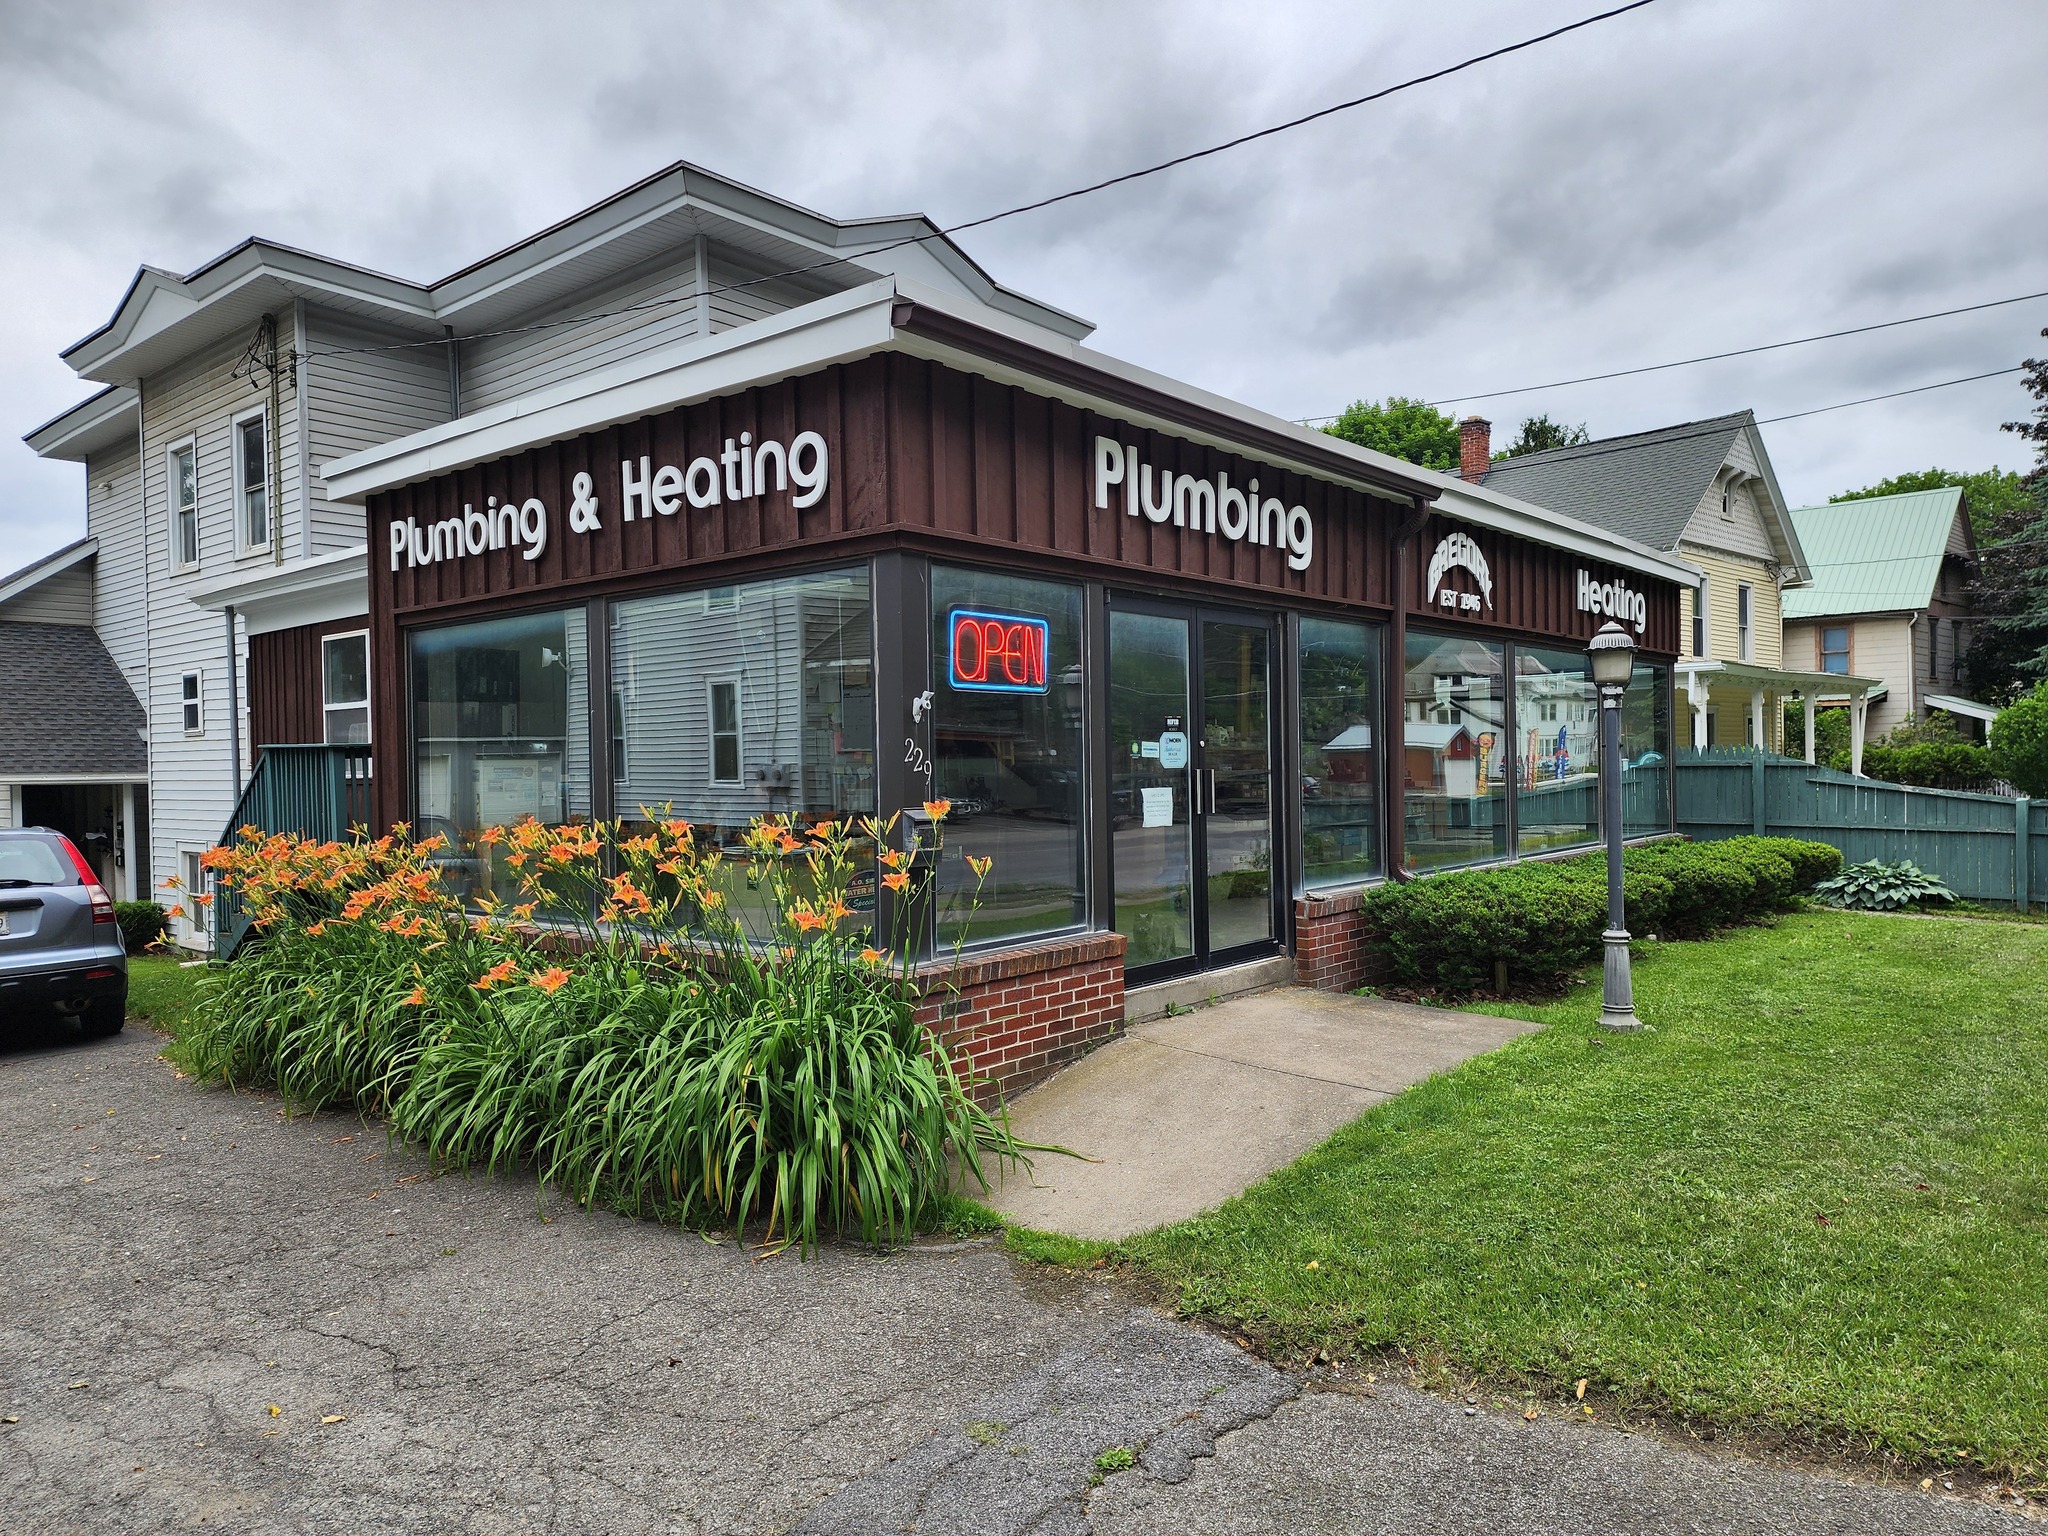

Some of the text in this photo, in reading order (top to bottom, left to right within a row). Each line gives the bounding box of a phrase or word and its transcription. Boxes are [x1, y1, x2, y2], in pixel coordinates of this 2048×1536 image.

[390, 430, 829, 571] Plumbing & Heating
[1094, 435, 1314, 570] Plumbing
[1428, 532, 1493, 611] GREGORY
[1440, 589, 1458, 607] EST
[1577, 569, 1646, 634] Heating
[954, 618, 1046, 686] OPEN
[904, 737, 932, 785] 229
